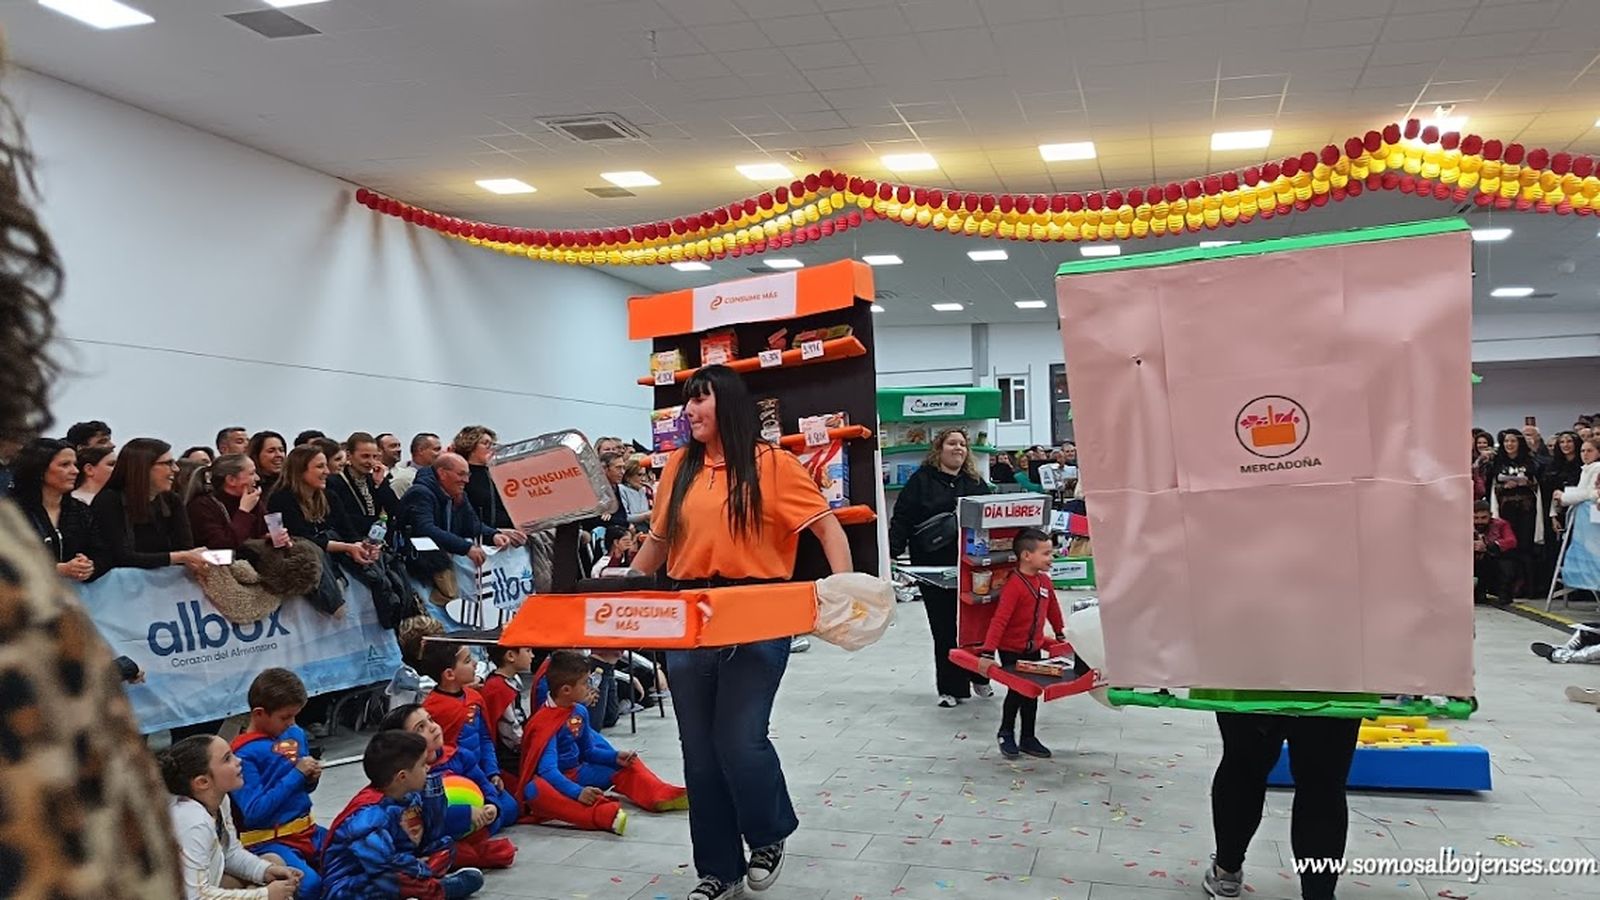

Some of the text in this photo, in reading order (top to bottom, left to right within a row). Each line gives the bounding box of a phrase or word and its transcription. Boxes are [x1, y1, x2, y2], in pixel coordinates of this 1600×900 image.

[725, 290, 778, 304] CONSUME MÁS
[1240, 457, 1321, 473] MERCADOÑA
[522, 467, 581, 487] CONSUME
[616, 606, 678, 618] CONSUME
[148, 600, 290, 656] albox
[616, 619, 640, 631] MÁS
[215, 650, 229, 661] del
